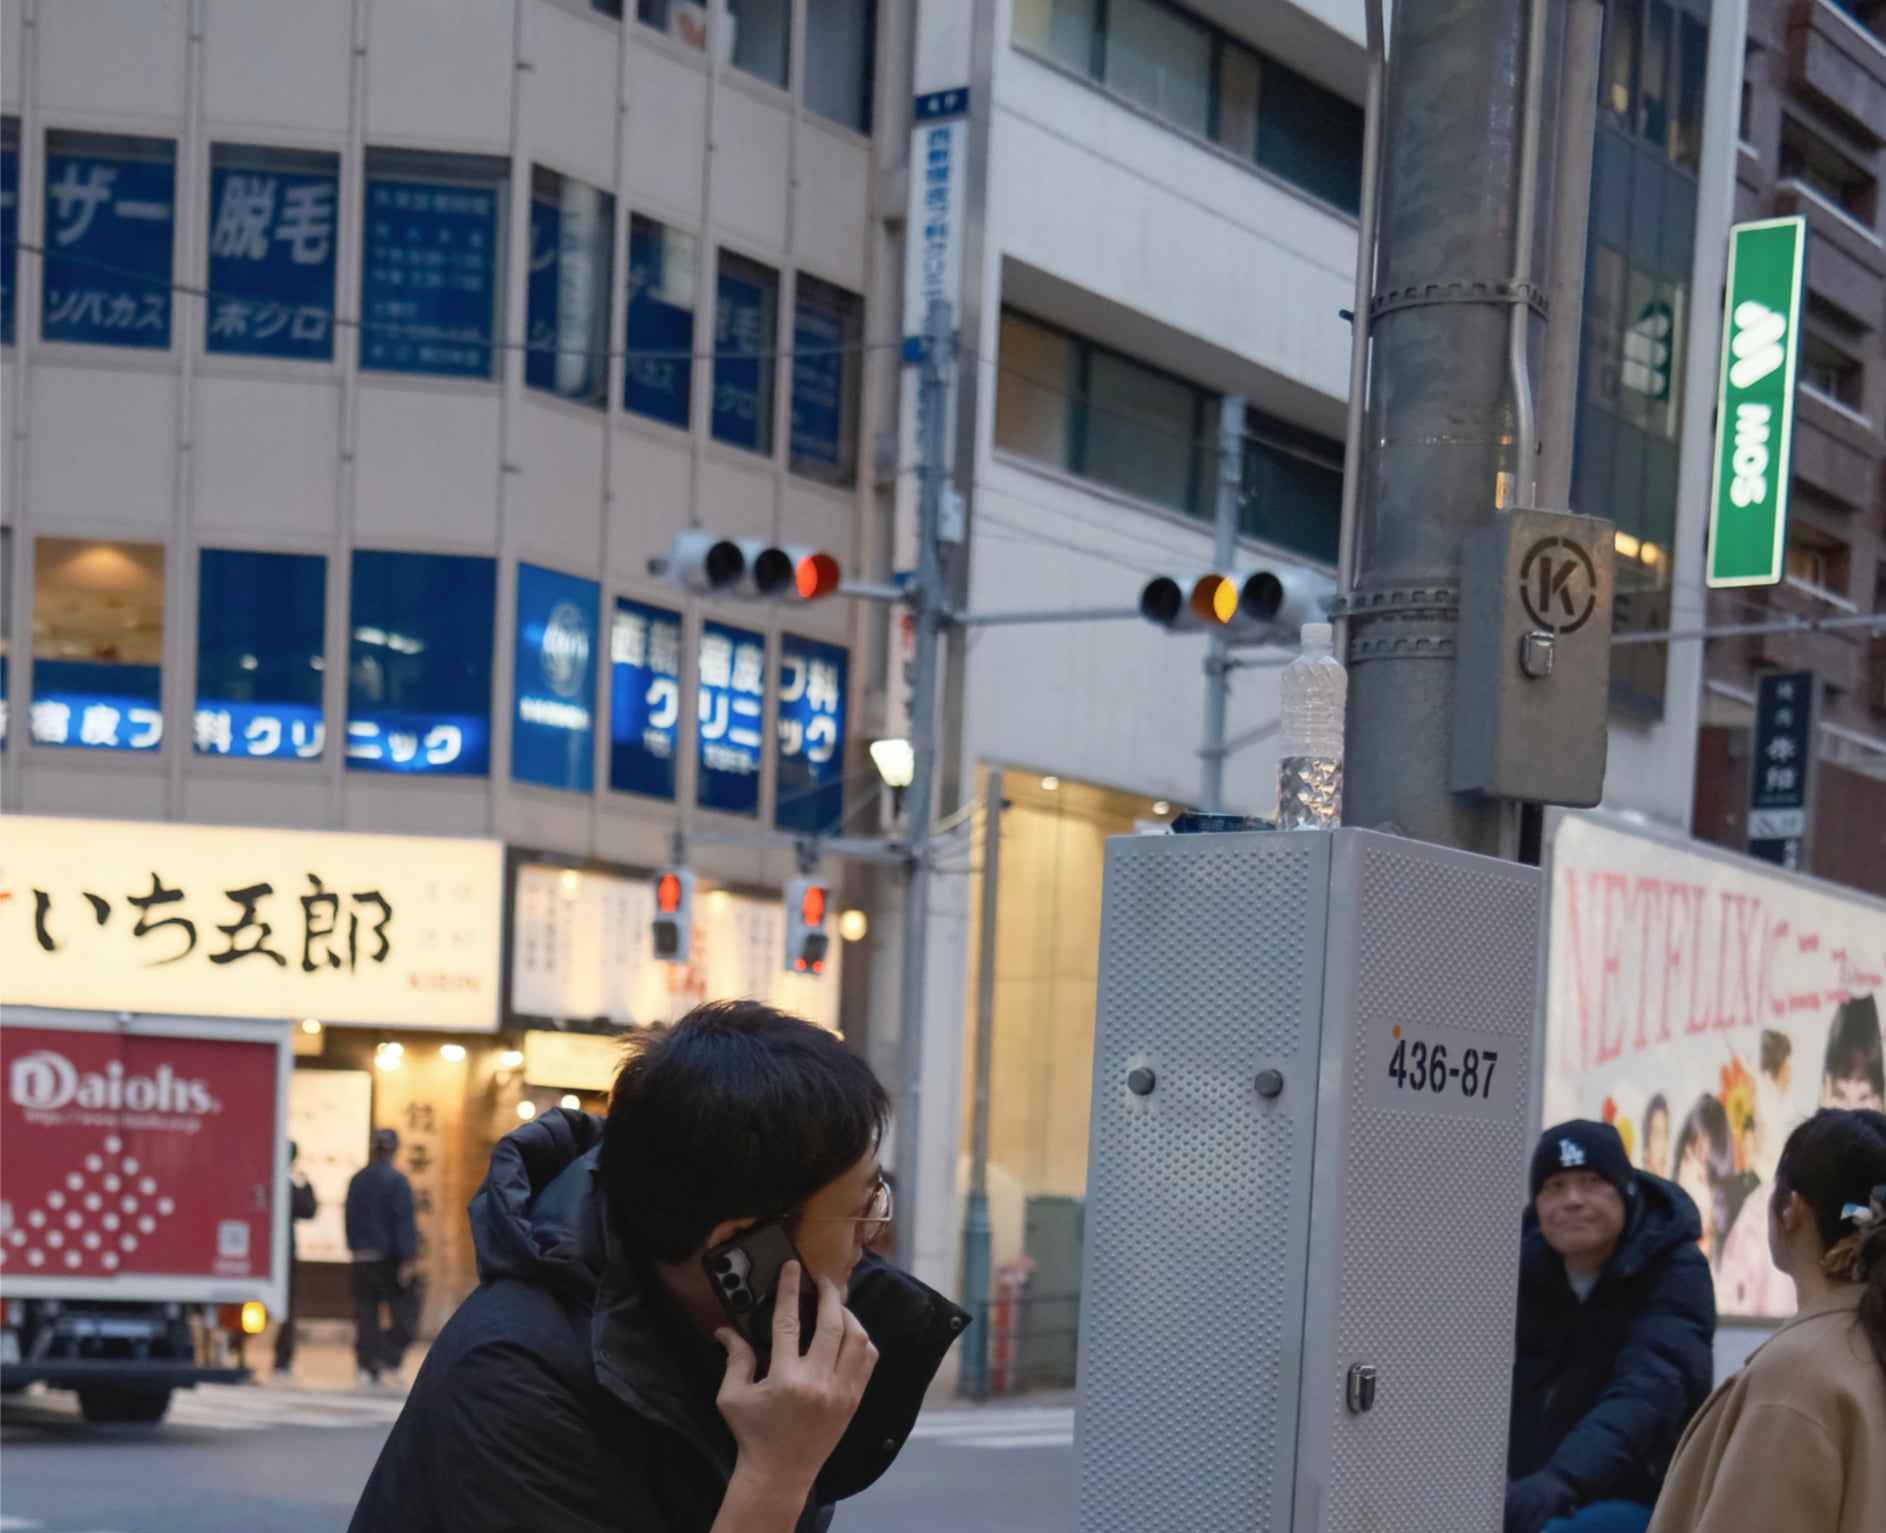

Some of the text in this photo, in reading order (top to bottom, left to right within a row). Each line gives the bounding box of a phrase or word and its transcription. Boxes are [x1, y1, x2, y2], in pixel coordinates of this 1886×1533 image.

[211, 174, 334, 264] 脱毛
[1730, 403, 1772, 508] MOS
[32, 871, 393, 974] いち五郎
[1557, 867, 1761, 1072] NETFLIX
[11, 1049, 213, 1115] Daiohs
[1388, 1039, 1498, 1099] 436-87
[1558, 1139, 1585, 1168] LA
